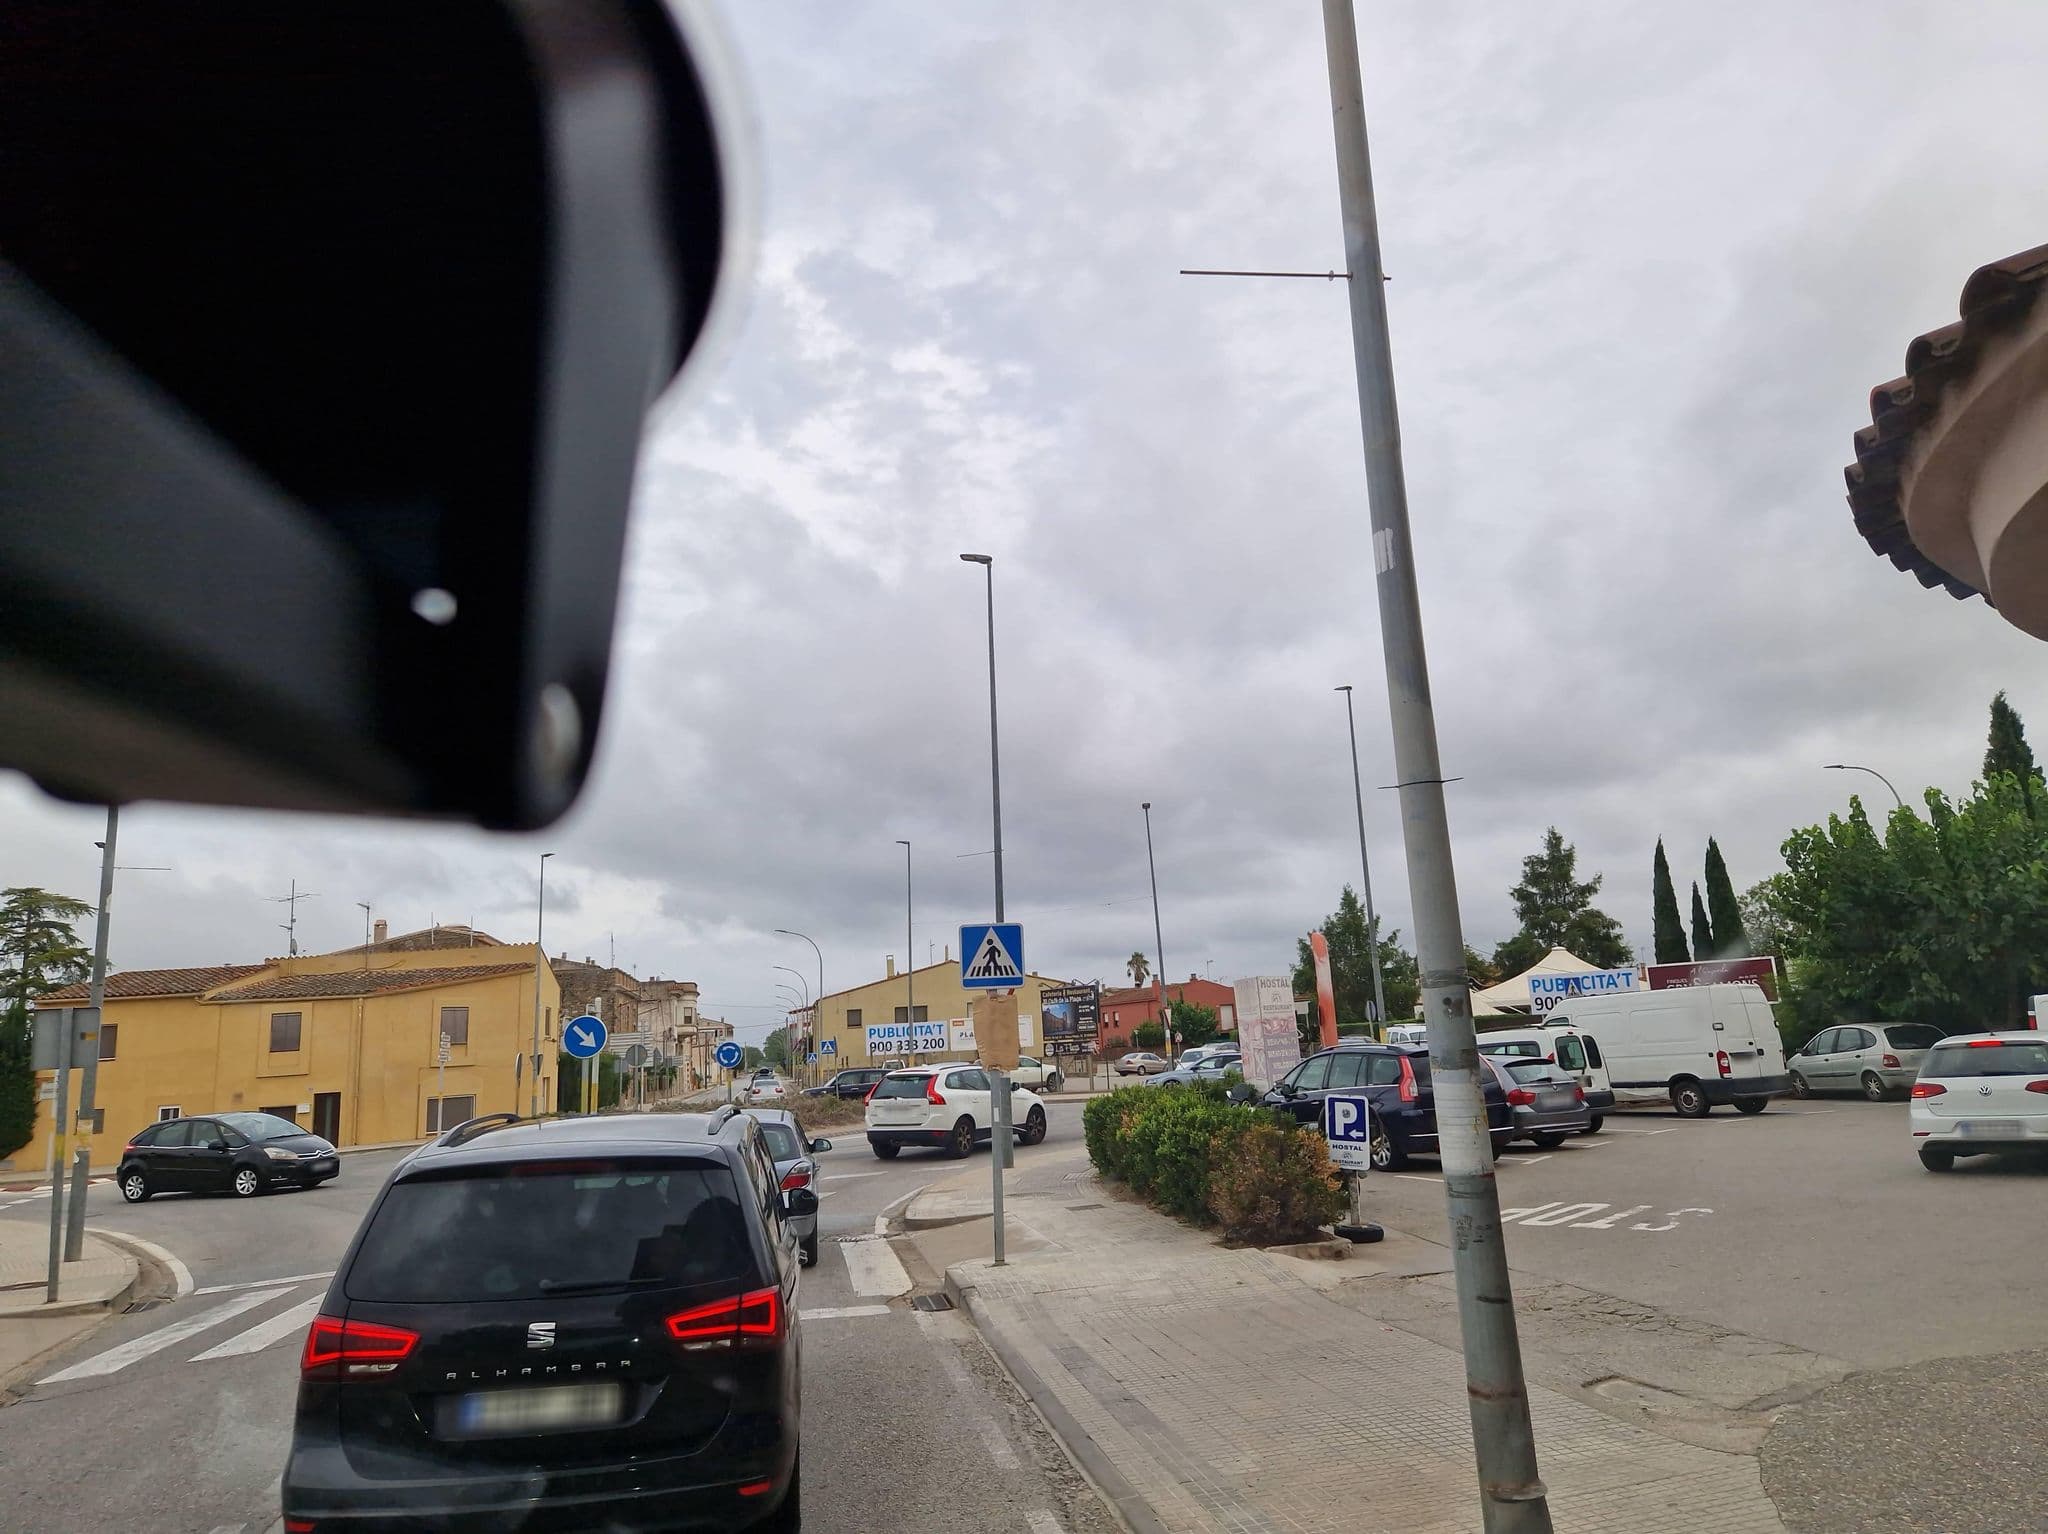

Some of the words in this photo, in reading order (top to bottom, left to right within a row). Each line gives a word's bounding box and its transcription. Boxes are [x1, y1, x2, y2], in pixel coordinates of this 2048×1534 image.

[1260, 979, 1289, 989] HOSTAL
[1531, 972, 1632, 993] PUBCITA'T
[1263, 1003, 1293, 1012] RESTAURANT
[869, 1040, 893, 1053] 900
[922, 1037, 945, 1050] 200
[1334, 1101, 1358, 1136] P
[1332, 1143, 1364, 1152] HOSTAL
[446, 1359, 631, 1381] ALHAMBRA
